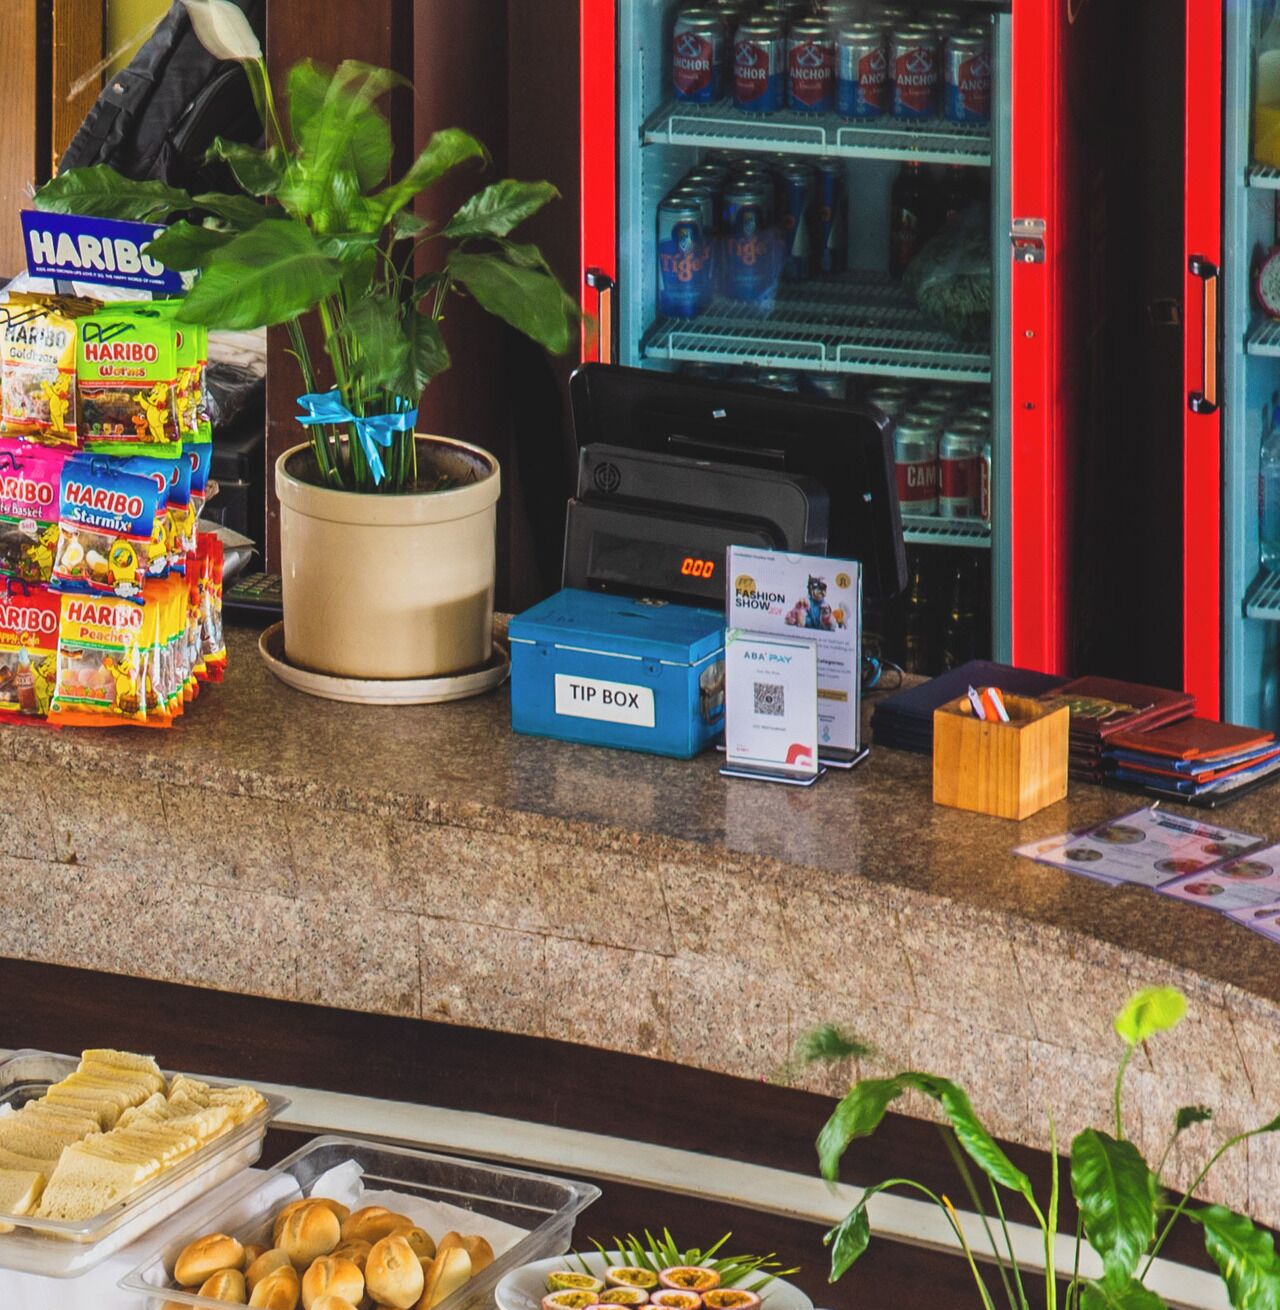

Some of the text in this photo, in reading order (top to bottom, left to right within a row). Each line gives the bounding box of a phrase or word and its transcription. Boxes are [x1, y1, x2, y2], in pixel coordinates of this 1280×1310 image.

[84, 342, 158, 363] HARIBO
[99, 366, 146, 378] Worms
[65, 481, 145, 519] HARIBO
[71, 506, 129, 532] Starmix
[735, 588, 786, 604] FASHION
[735, 597, 770, 611] SHOW
[66, 601, 144, 628] HARIBO
[768, 653, 793, 664] PAY
[570, 683, 640, 710] TIP BOX
